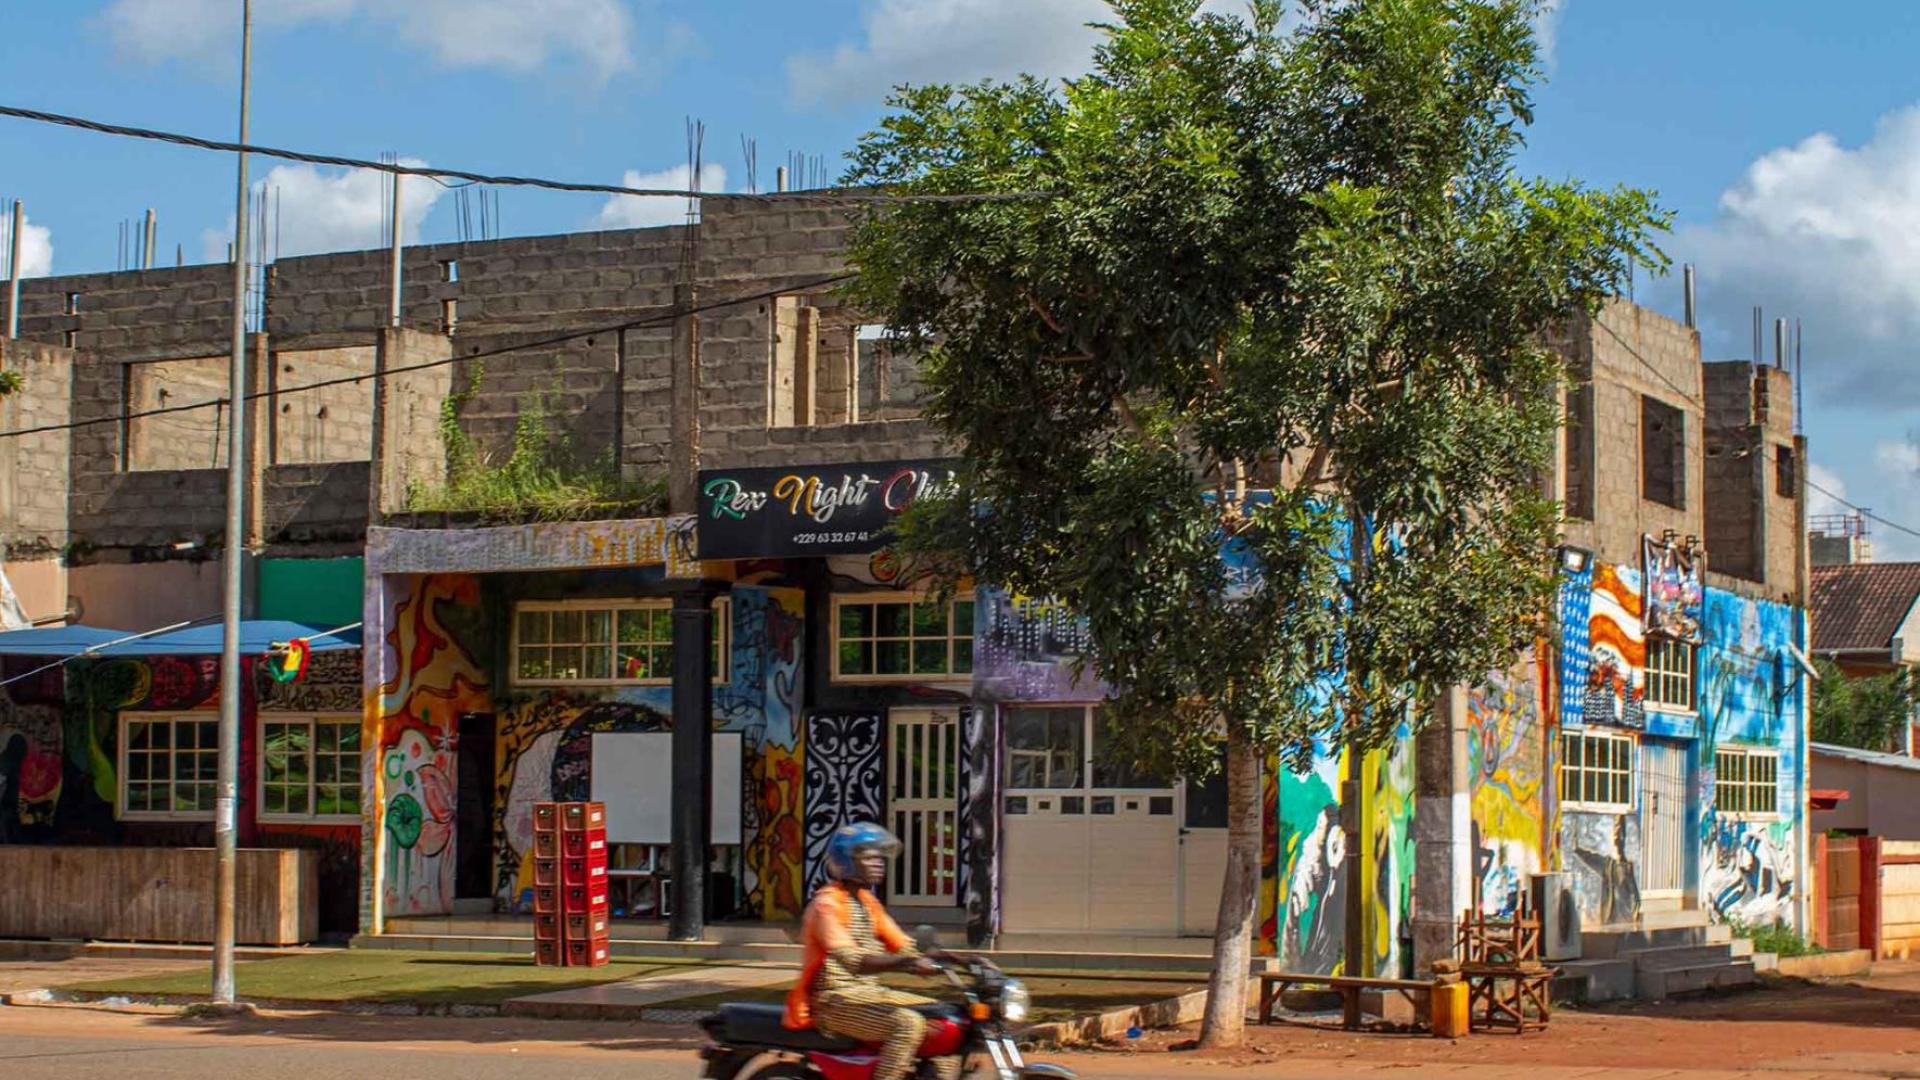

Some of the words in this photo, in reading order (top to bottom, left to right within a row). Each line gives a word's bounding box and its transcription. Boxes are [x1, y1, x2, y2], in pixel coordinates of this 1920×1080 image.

[703, 477, 768, 521] Rex
[772, 472, 881, 524] Night
[793, 533, 816, 544] +229
[817, 532, 830, 543] 63
[831, 532, 844, 543] 32
[844, 531, 857, 542] 67
